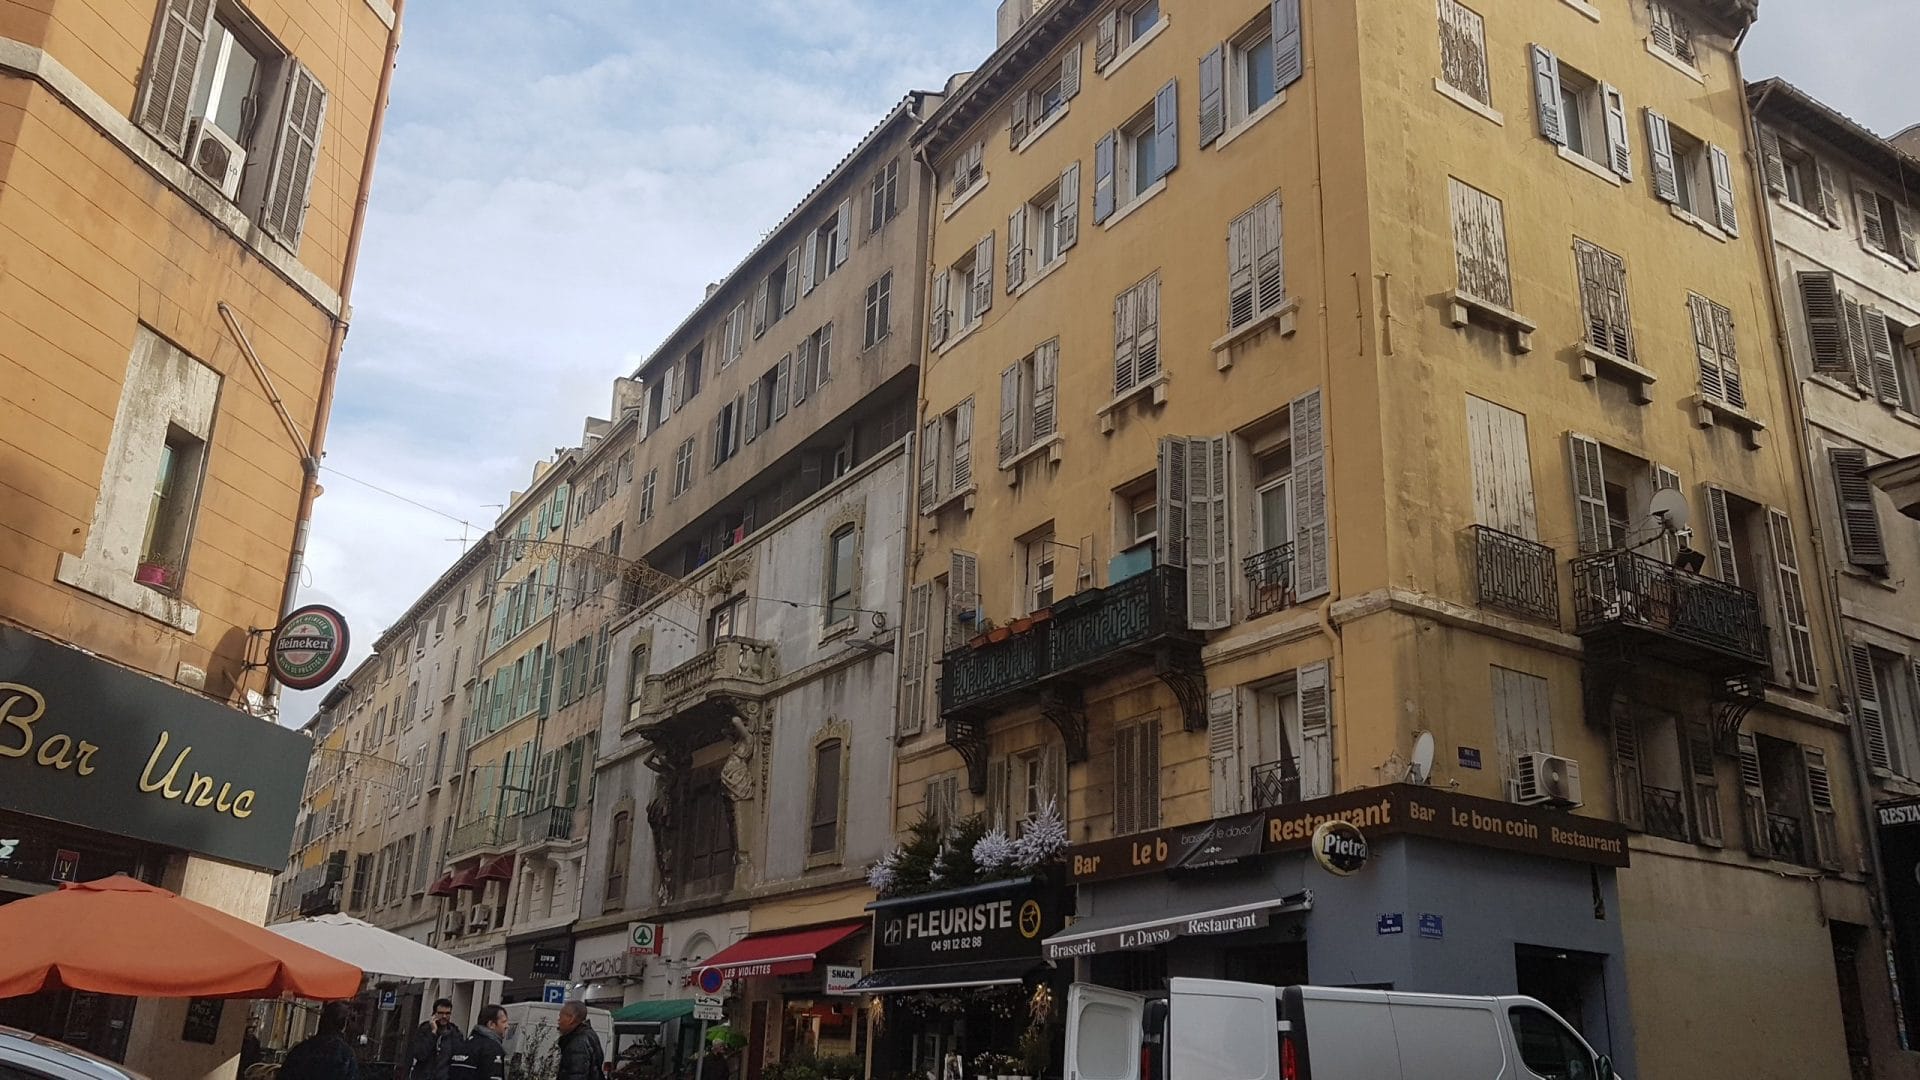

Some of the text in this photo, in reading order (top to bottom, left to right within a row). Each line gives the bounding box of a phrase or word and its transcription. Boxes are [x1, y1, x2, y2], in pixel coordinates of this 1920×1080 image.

[279, 637, 329, 649] Heineken
[0, 681, 256, 818] Bar Unic
[1409, 801, 1621, 853] Bar Le bon coin Restaurant
[1879, 804, 1920, 825] RESTA
[1323, 833, 1367, 858] Pietra
[1074, 854, 1100, 875] Bar
[1132, 842, 1151, 866] Le
[906, 900, 1013, 939] FLEURISTE
[931, 935, 982, 951] 04 91 12 82 88
[1050, 912, 1257, 959] Brasserie Le Davso Restaurant
[724, 964, 771, 978] LES VIOLETTES
[832, 969, 856, 979] SNACK
